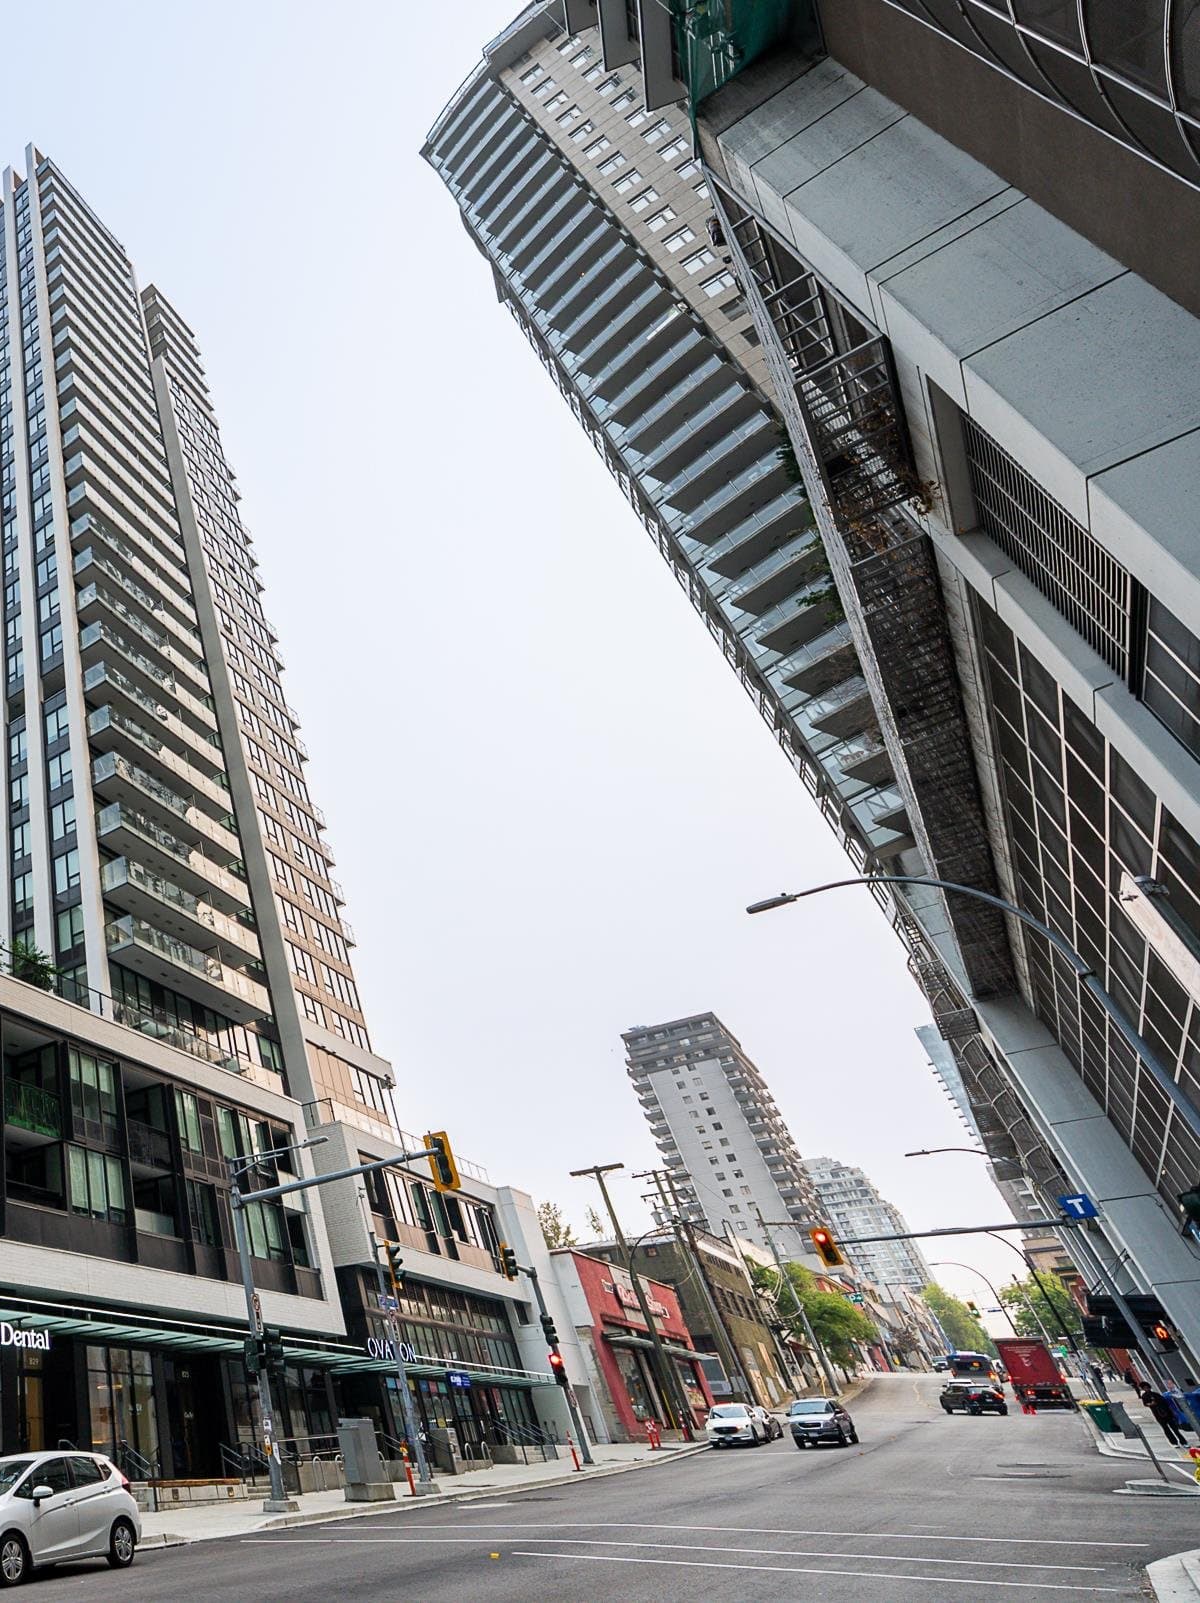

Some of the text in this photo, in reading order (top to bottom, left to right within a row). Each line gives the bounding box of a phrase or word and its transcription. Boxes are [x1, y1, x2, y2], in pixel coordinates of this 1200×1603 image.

[1066, 1198, 1085, 1214] T
[0, 1322, 50, 1350] Dental
[367, 1338, 417, 1363] OVAON
